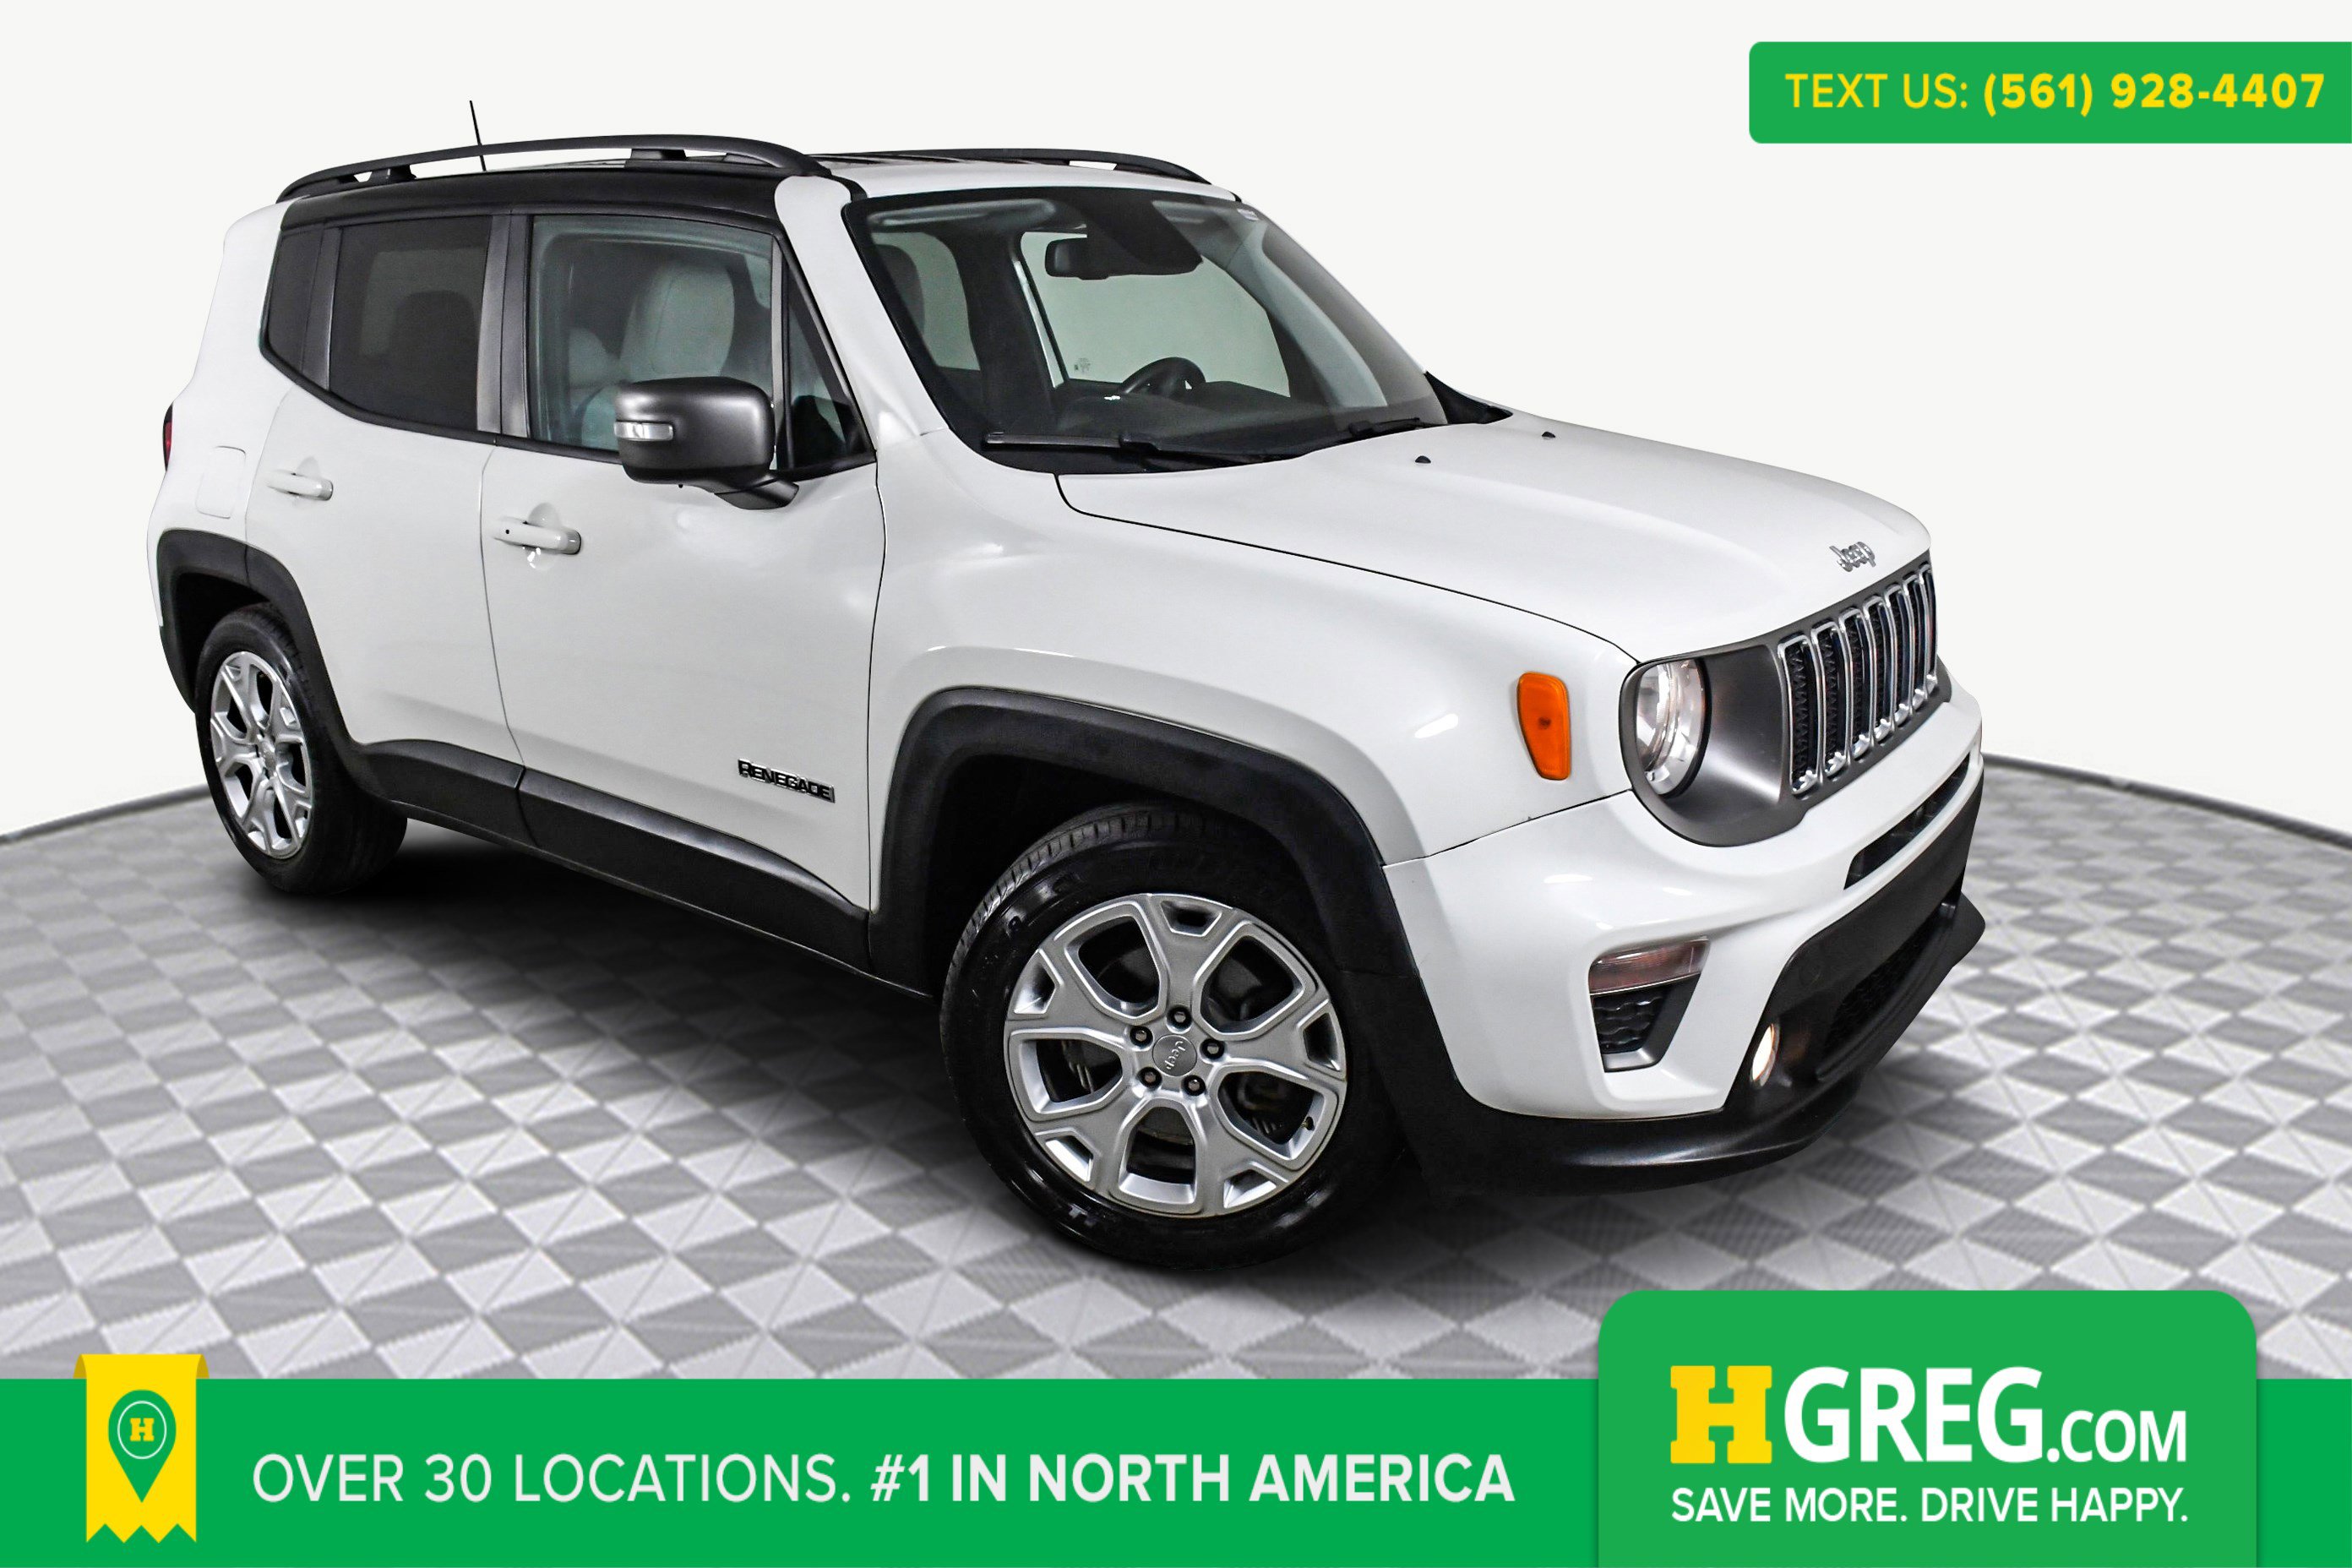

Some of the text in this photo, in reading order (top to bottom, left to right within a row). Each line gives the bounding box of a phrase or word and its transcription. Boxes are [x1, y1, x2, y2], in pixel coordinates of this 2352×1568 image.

[1828, 541, 1876, 572] Jeep
[738, 758, 836, 803] RENEGADE
[1164, 1040, 1186, 1070] Jeep
